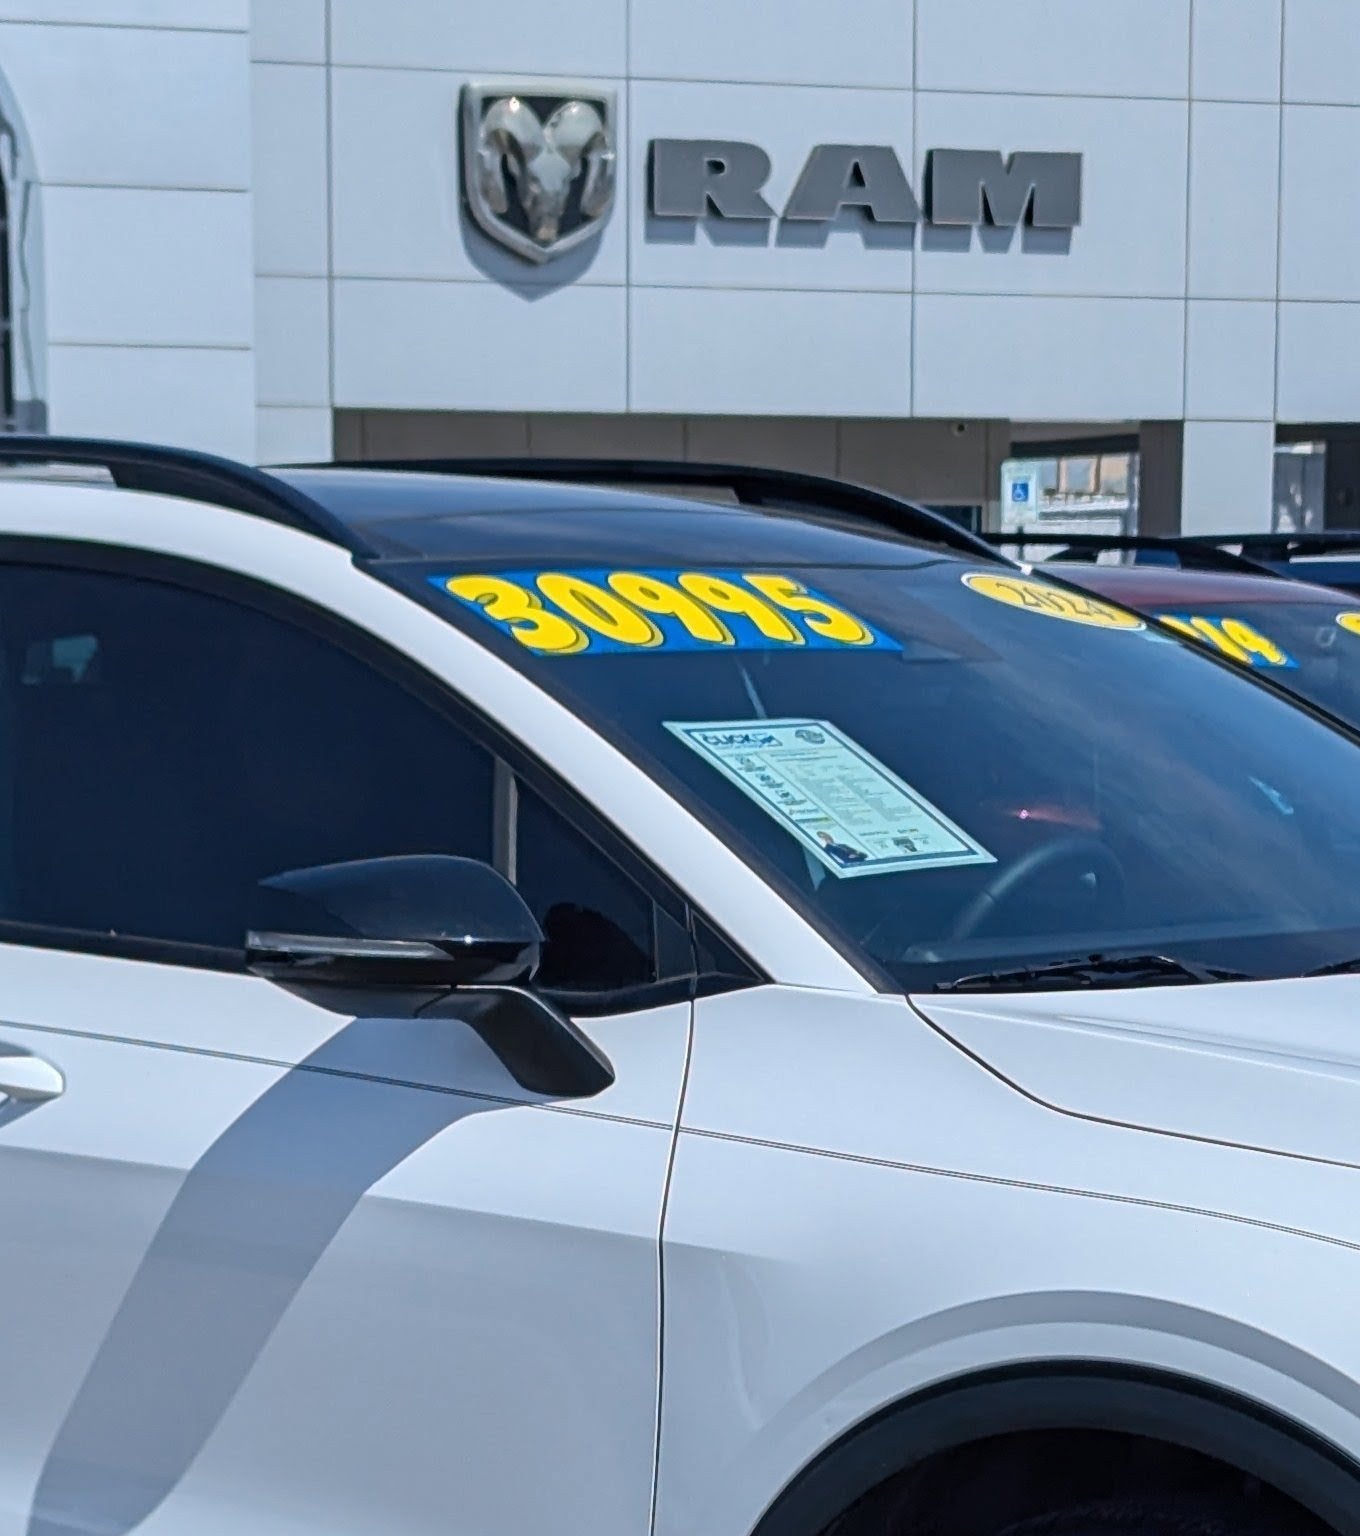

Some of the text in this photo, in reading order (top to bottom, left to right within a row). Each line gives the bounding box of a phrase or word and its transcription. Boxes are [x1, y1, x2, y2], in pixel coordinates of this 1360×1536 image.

[645, 137, 1083, 228] RAM
[445, 572, 876, 654] 30995
[995, 582, 1118, 622] 2024
